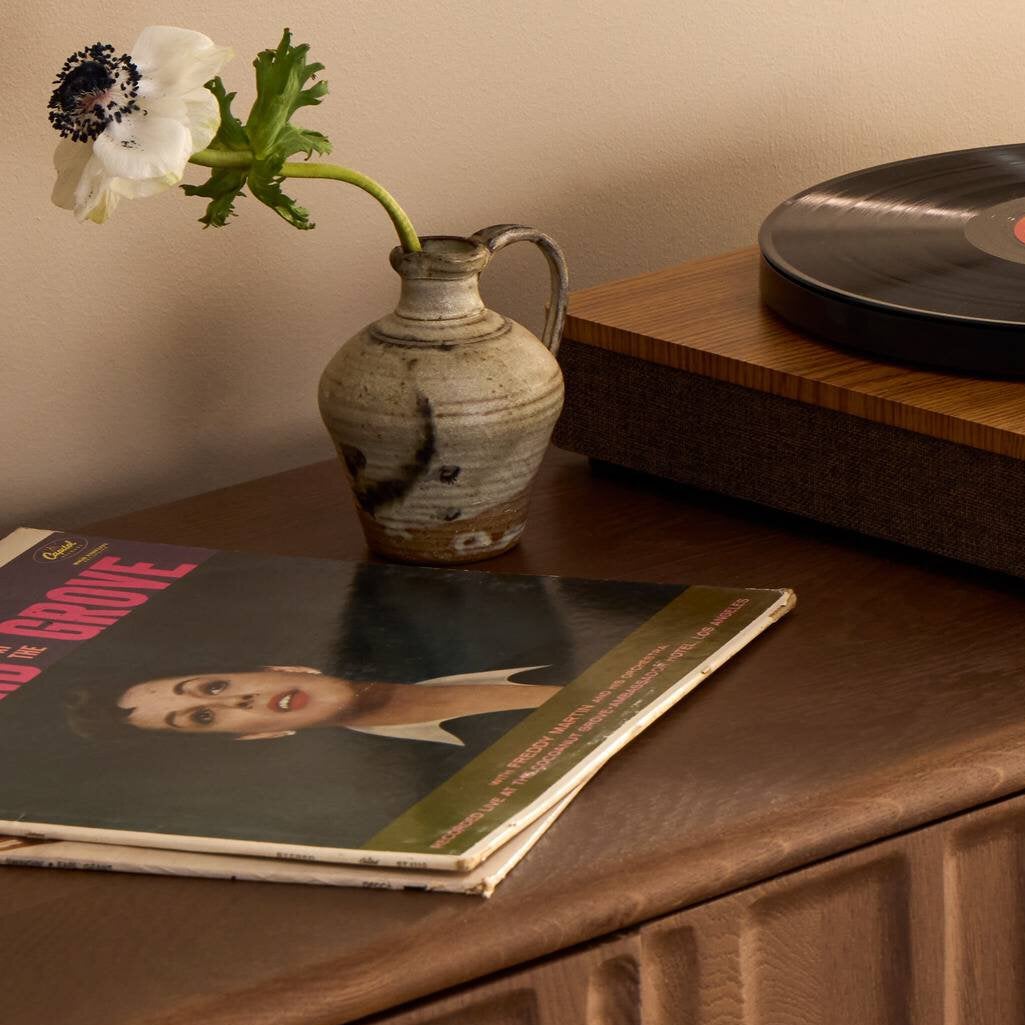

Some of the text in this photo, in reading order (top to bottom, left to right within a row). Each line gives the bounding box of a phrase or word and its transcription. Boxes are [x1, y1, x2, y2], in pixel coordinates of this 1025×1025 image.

[42, 539, 77, 560] Capitol
[0, 556, 199, 641] GROVE
[7, 645, 48, 659] THE
[430, 811, 485, 848] RECORDED
[478, 797, 506, 812] LIVE
[499, 787, 518, 797] AT
[691, 626, 715, 640] LOS
[710, 598, 751, 626] ANGELES
[507, 735, 554, 768] FREDDY
[549, 704, 596, 734] MARTIN
[592, 690, 612, 703] AND
[621, 643, 671, 679] ORCHESTRA
